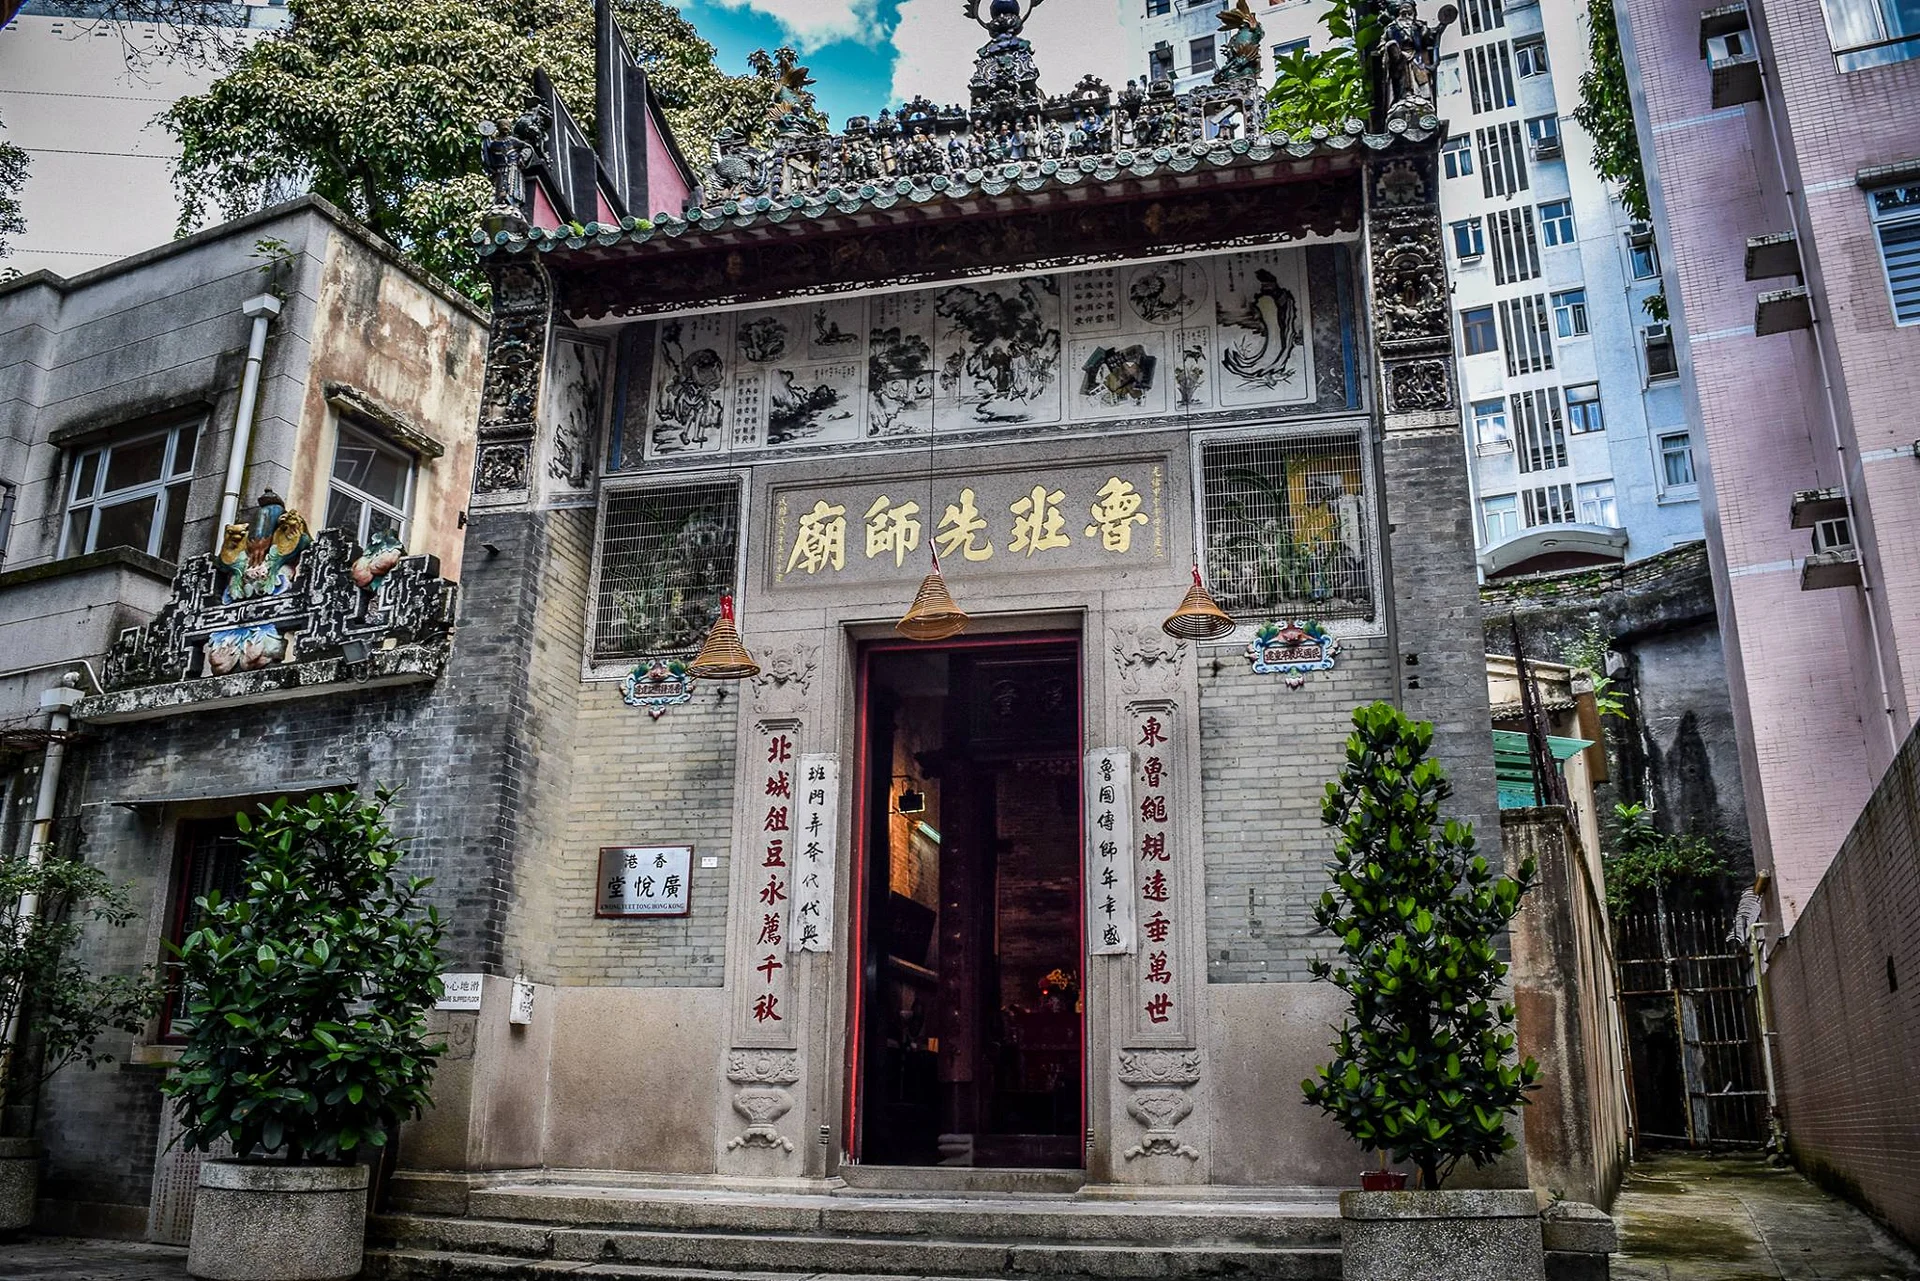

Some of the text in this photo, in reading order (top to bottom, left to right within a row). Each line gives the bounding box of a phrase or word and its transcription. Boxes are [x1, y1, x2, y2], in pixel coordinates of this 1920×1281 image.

[786, 476, 1149, 574] 魯班先師廟
[624, 852, 668, 869] 香港
